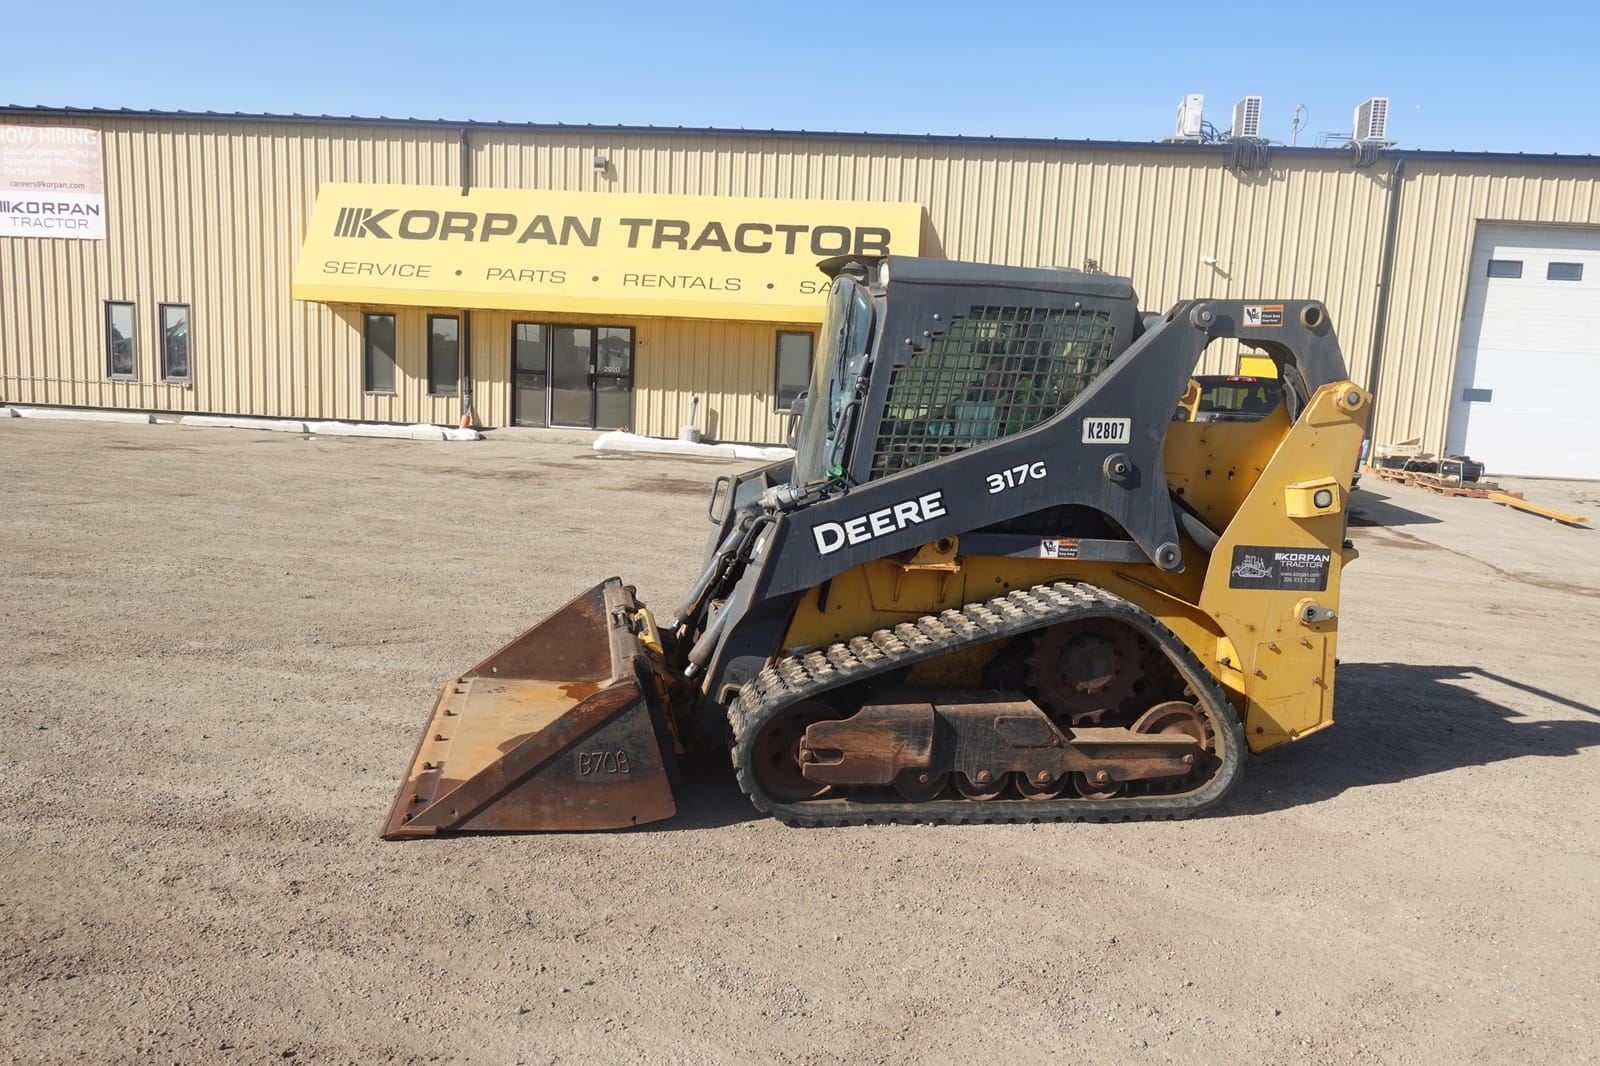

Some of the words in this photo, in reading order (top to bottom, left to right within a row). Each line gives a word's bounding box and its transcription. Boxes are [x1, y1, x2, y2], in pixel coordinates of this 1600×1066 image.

[40, 128, 96, 144] HIRING
[10, 201, 100, 216] KORPAN
[9, 216, 89, 230] TRACTOR
[334, 207, 602, 247] KORPAN
[619, 217, 892, 256] TRACTOR
[322, 260, 433, 278] SERVICE
[486, 267, 567, 284] PARTS
[622, 273, 742, 292] RENTALS
[800, 280, 833, 295] SA
[1087, 421, 1125, 440] K2807
[985, 461, 1048, 495] 317G
[812, 491, 946, 556] DEERE
[1274, 553, 1330, 562] KORPAN
